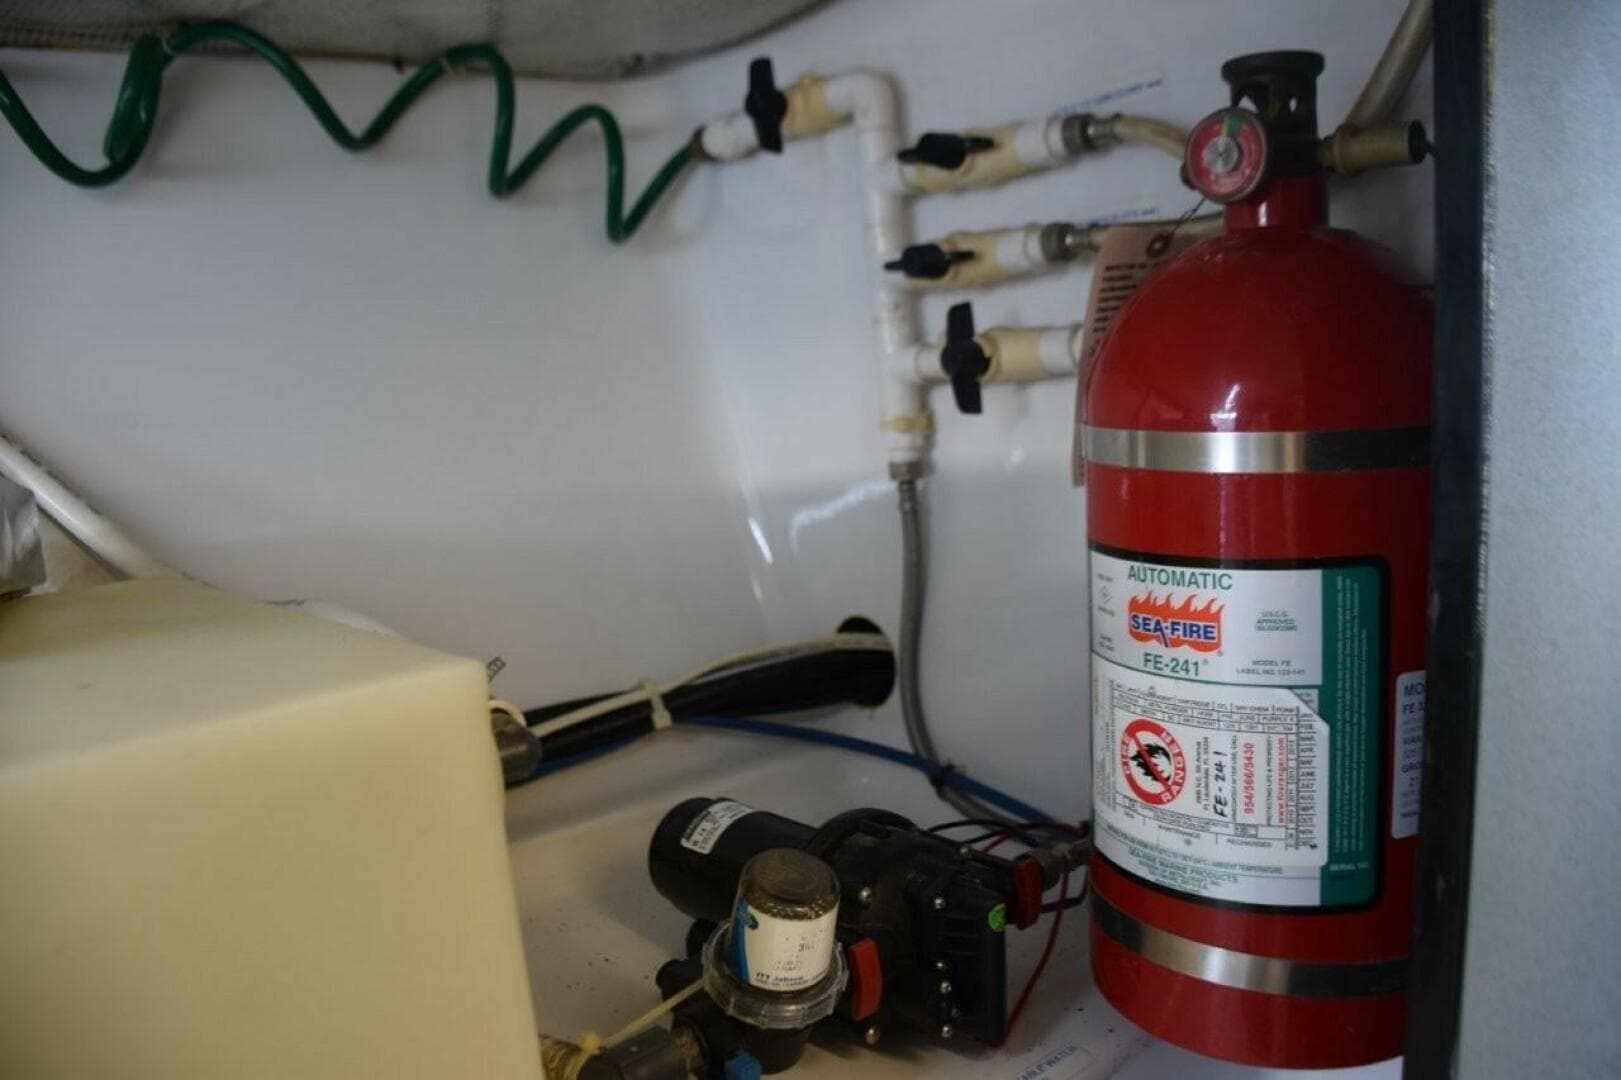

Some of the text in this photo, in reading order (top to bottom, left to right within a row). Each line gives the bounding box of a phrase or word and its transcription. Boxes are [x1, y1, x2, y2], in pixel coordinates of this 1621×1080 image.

[1128, 565, 1234, 591] AUTOMATIC
[1143, 652, 1200, 677] FE-241
[1161, 730, 1184, 803] RANGER
[1243, 742, 1255, 815] 954/566/5430
